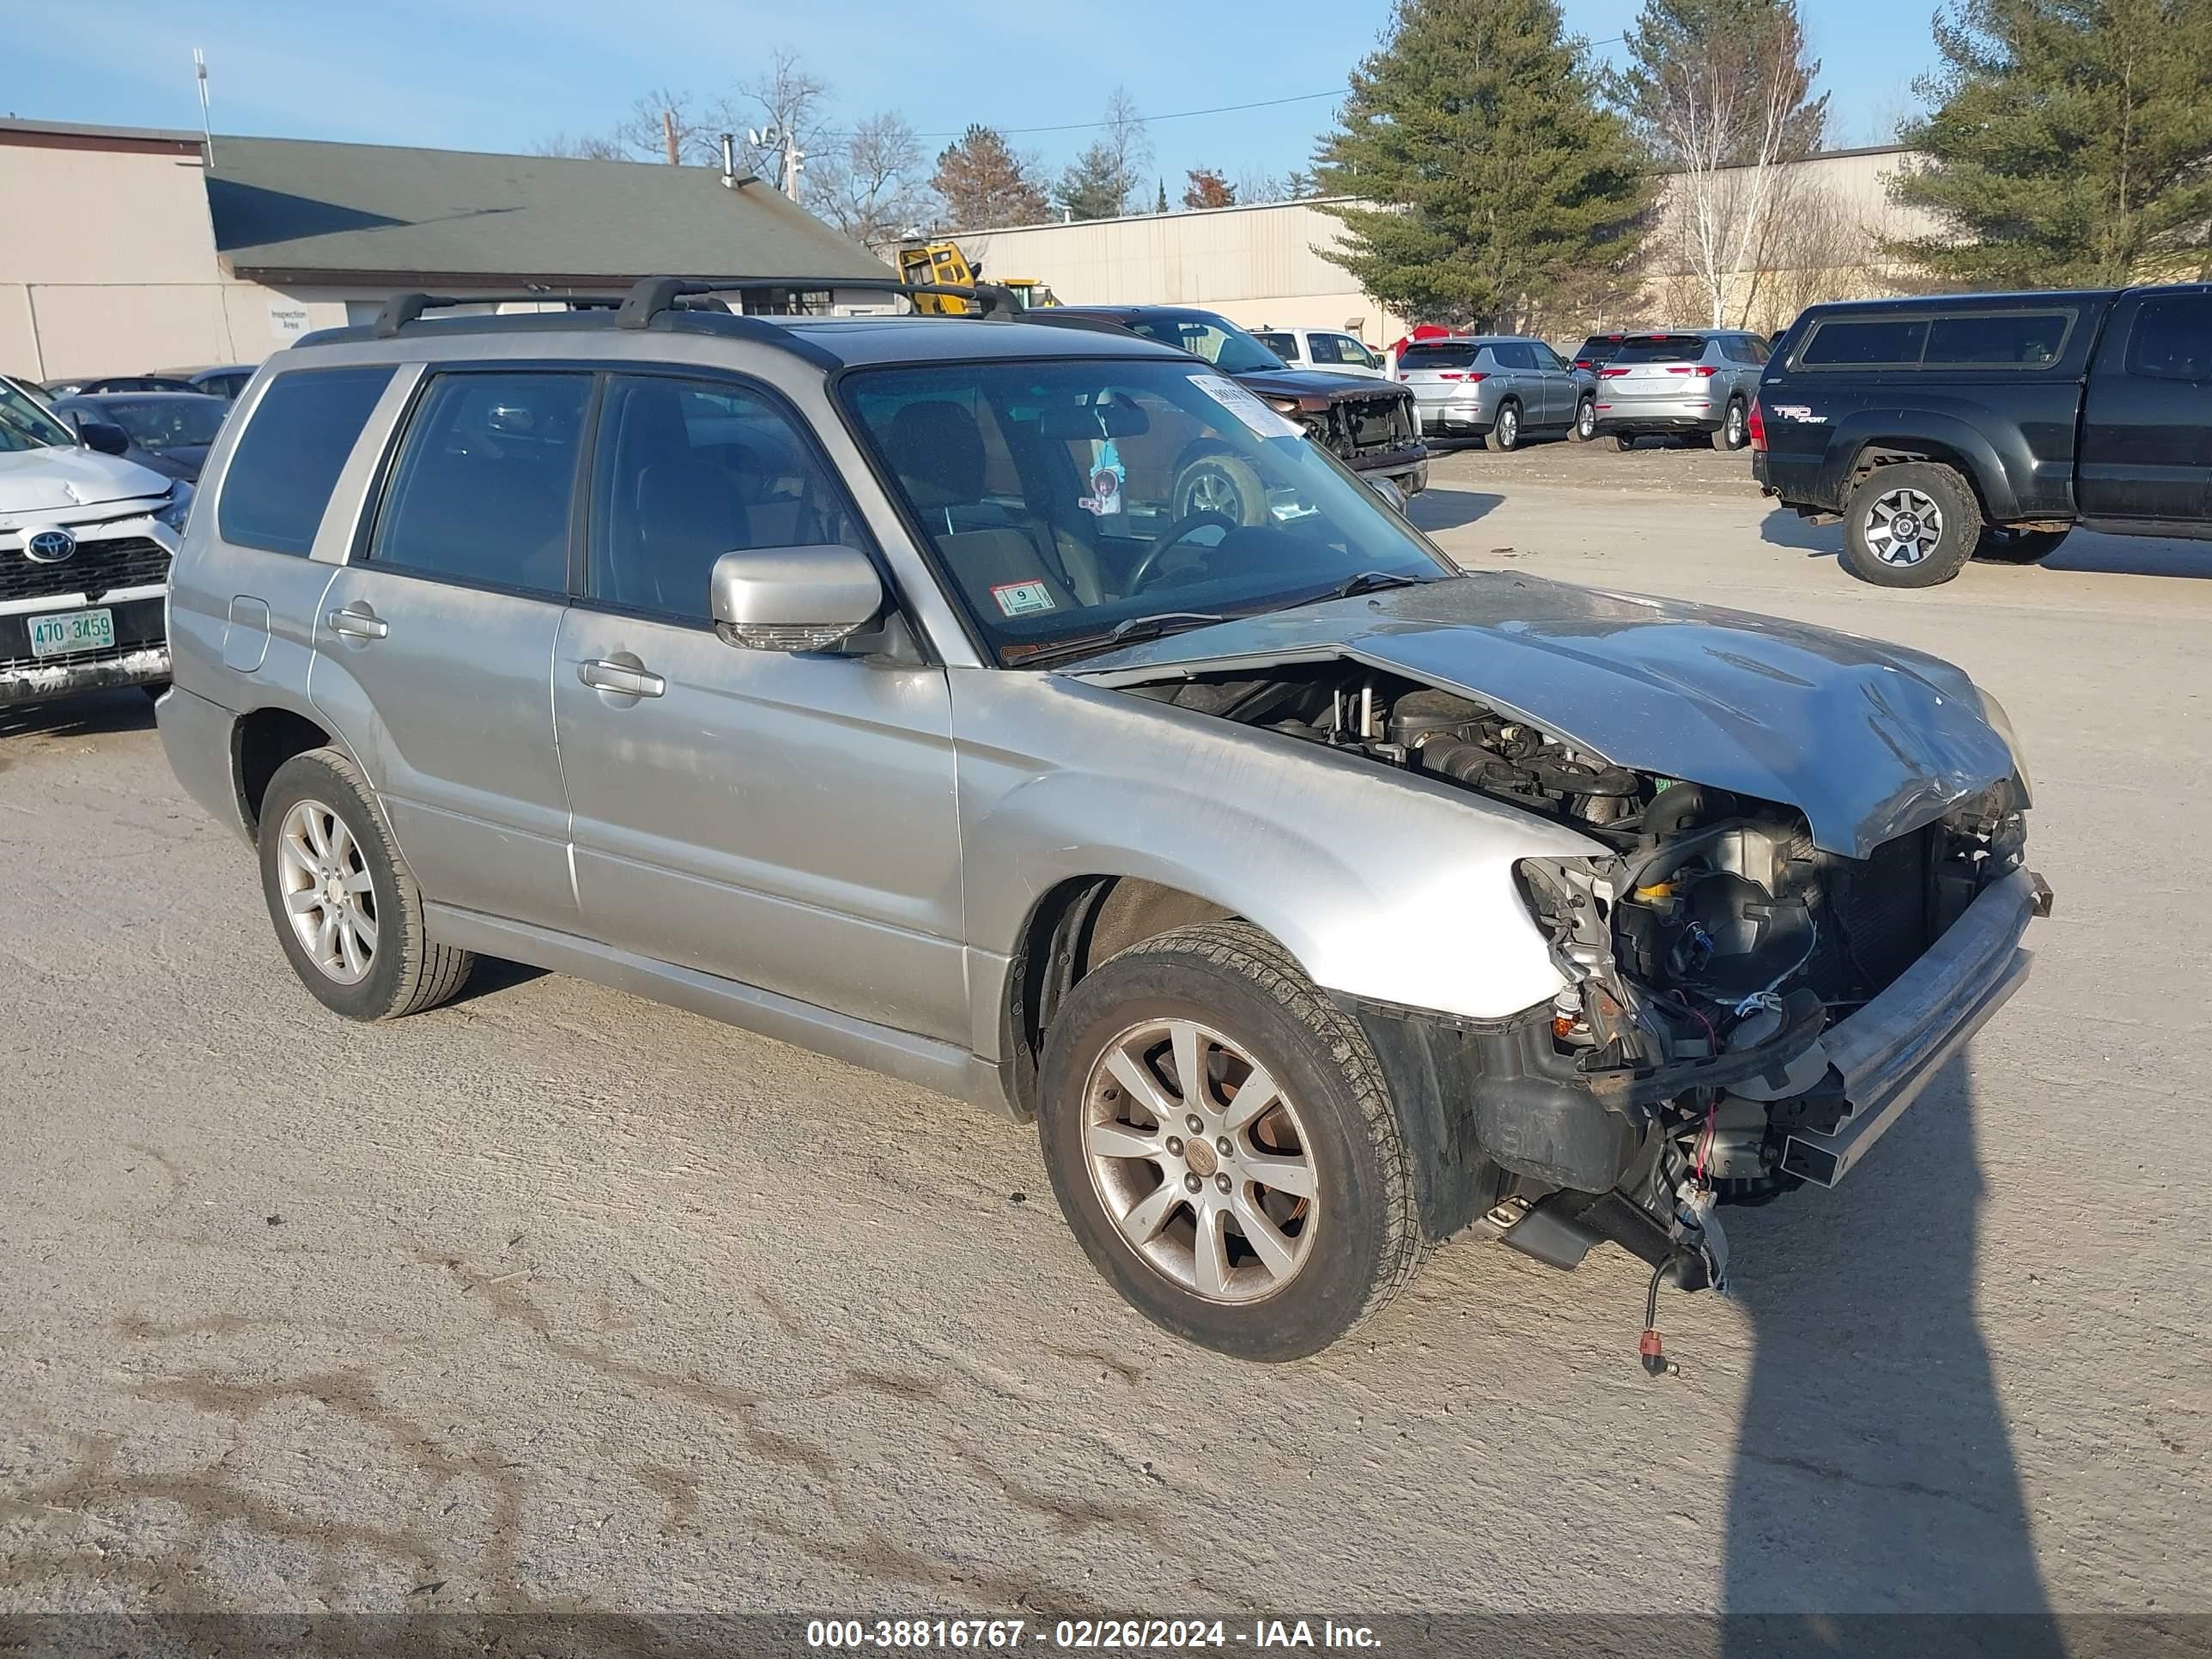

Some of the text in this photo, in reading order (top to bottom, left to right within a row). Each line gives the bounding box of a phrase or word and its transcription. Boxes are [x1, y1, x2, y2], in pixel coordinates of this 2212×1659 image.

[270, 309, 307, 319] Inspection
[283, 320, 299, 330] Area
[1773, 406, 1812, 419] TRD
[1017, 590, 1027, 600] 9
[36, 623, 64, 643] 470
[72, 617, 110, 639] 3459
